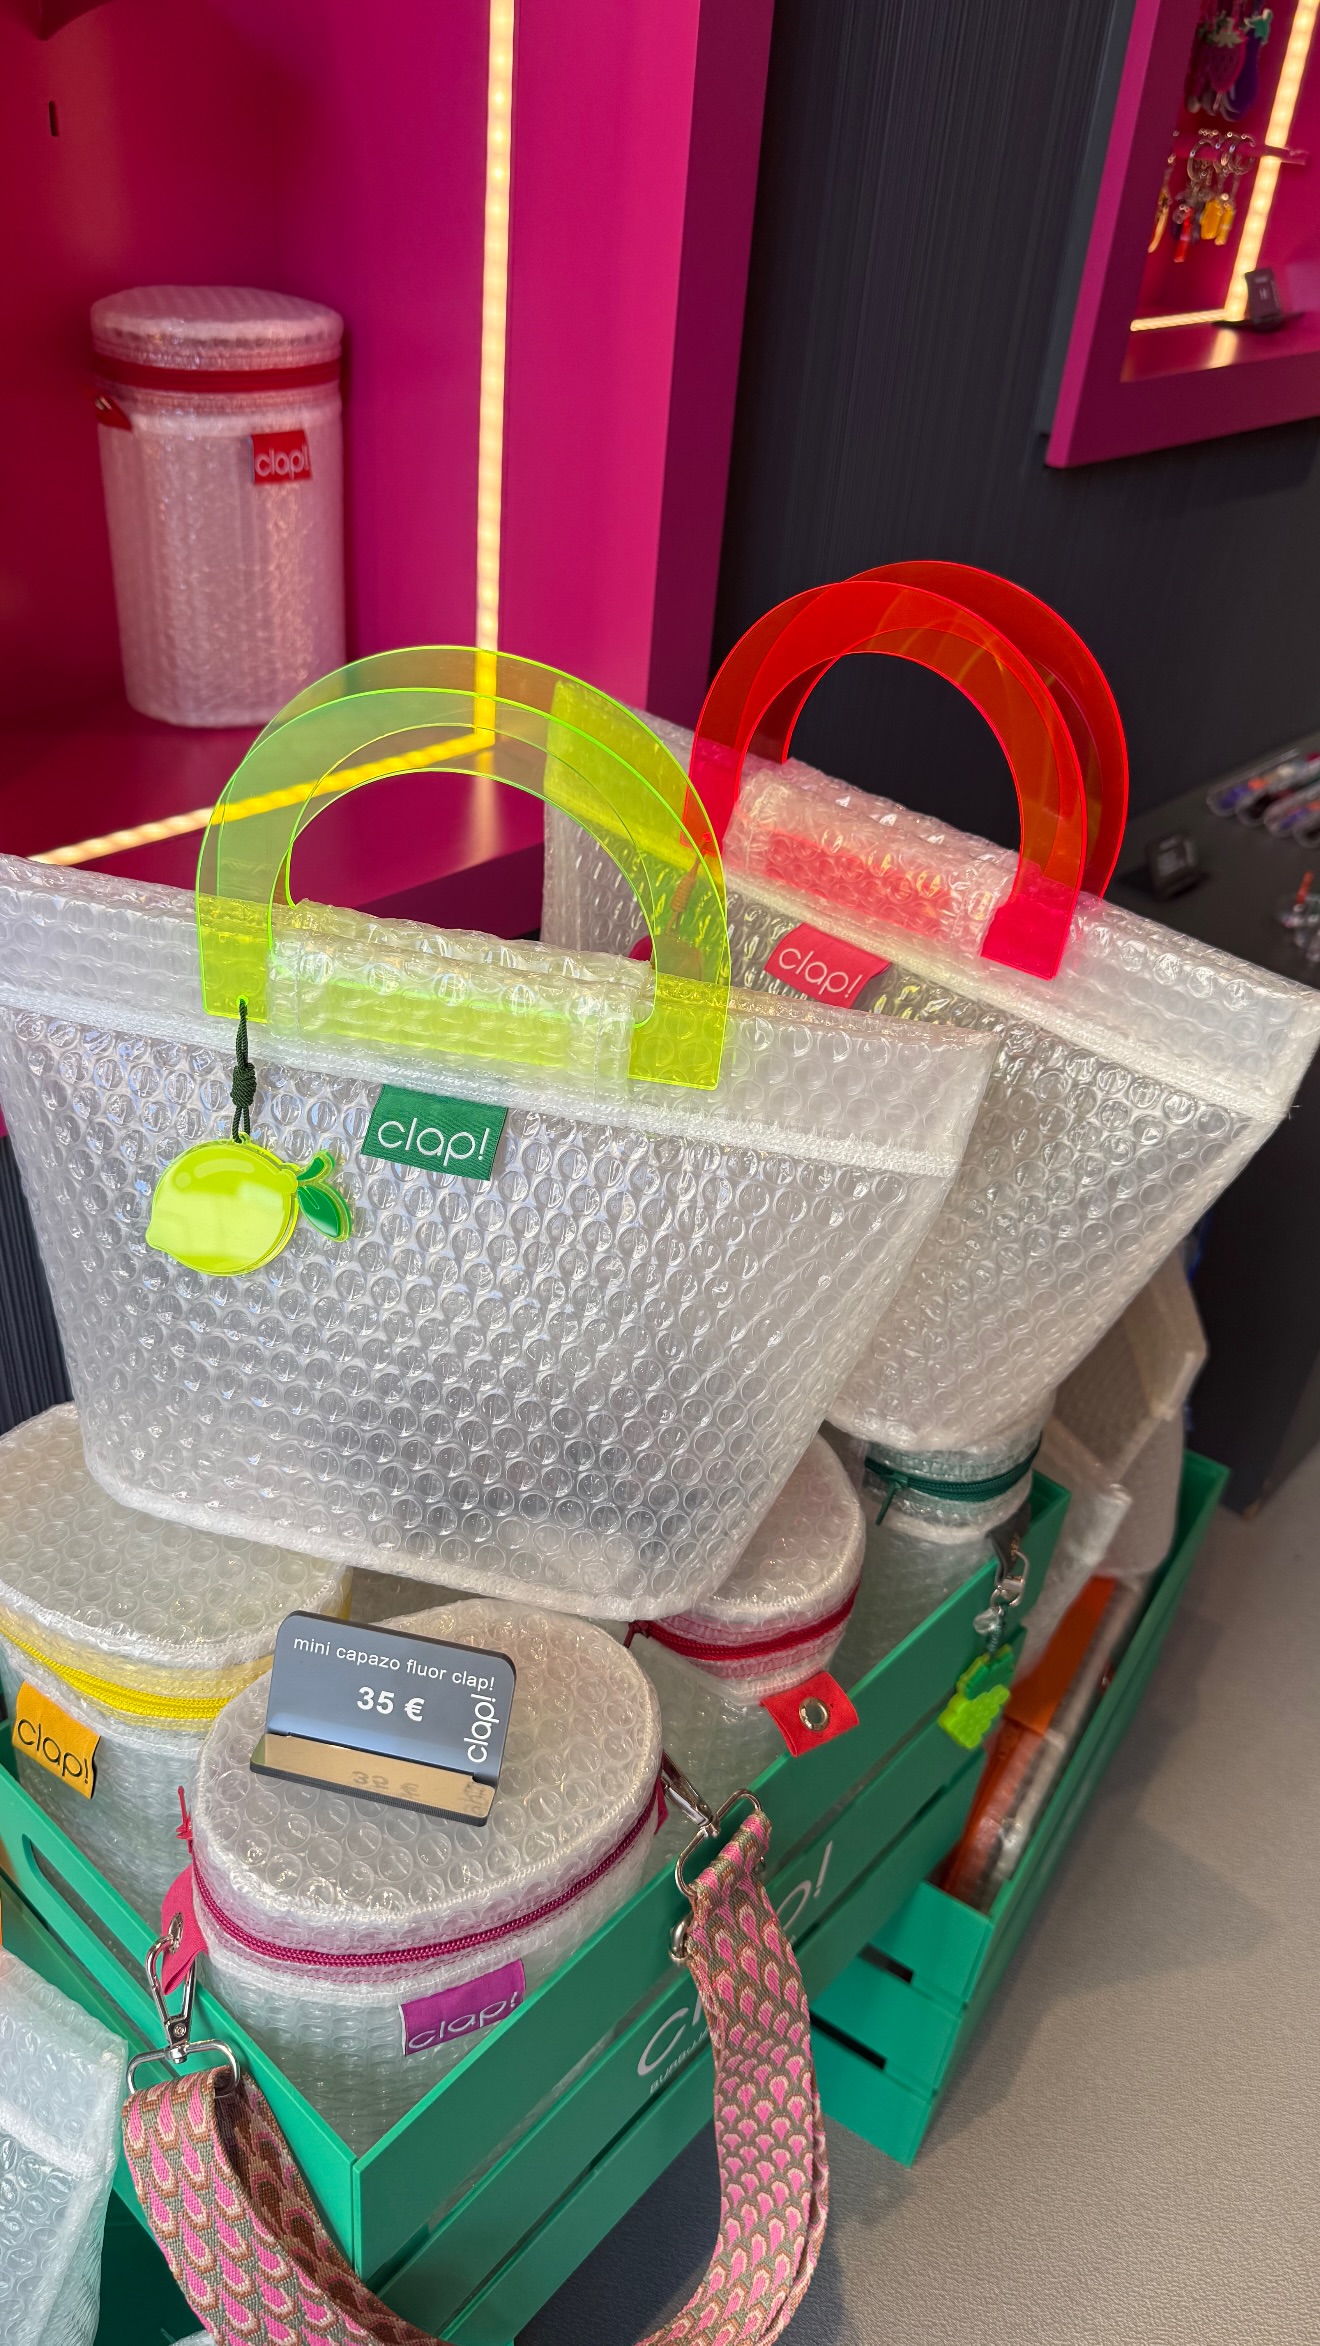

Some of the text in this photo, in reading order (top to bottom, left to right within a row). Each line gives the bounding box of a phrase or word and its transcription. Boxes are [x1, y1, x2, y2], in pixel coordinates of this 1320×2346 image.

[254, 445, 310, 481] clap!
[778, 948, 864, 999] clap!
[377, 1116, 491, 1168] clap!
[293, 1637, 496, 1692] mini capazo fluor clap!
[356, 1685, 426, 1723] 35 €
[463, 1692, 500, 1764] clap!
[17, 1718, 84, 1785] clap!
[408, 1991, 519, 2050] clap!
